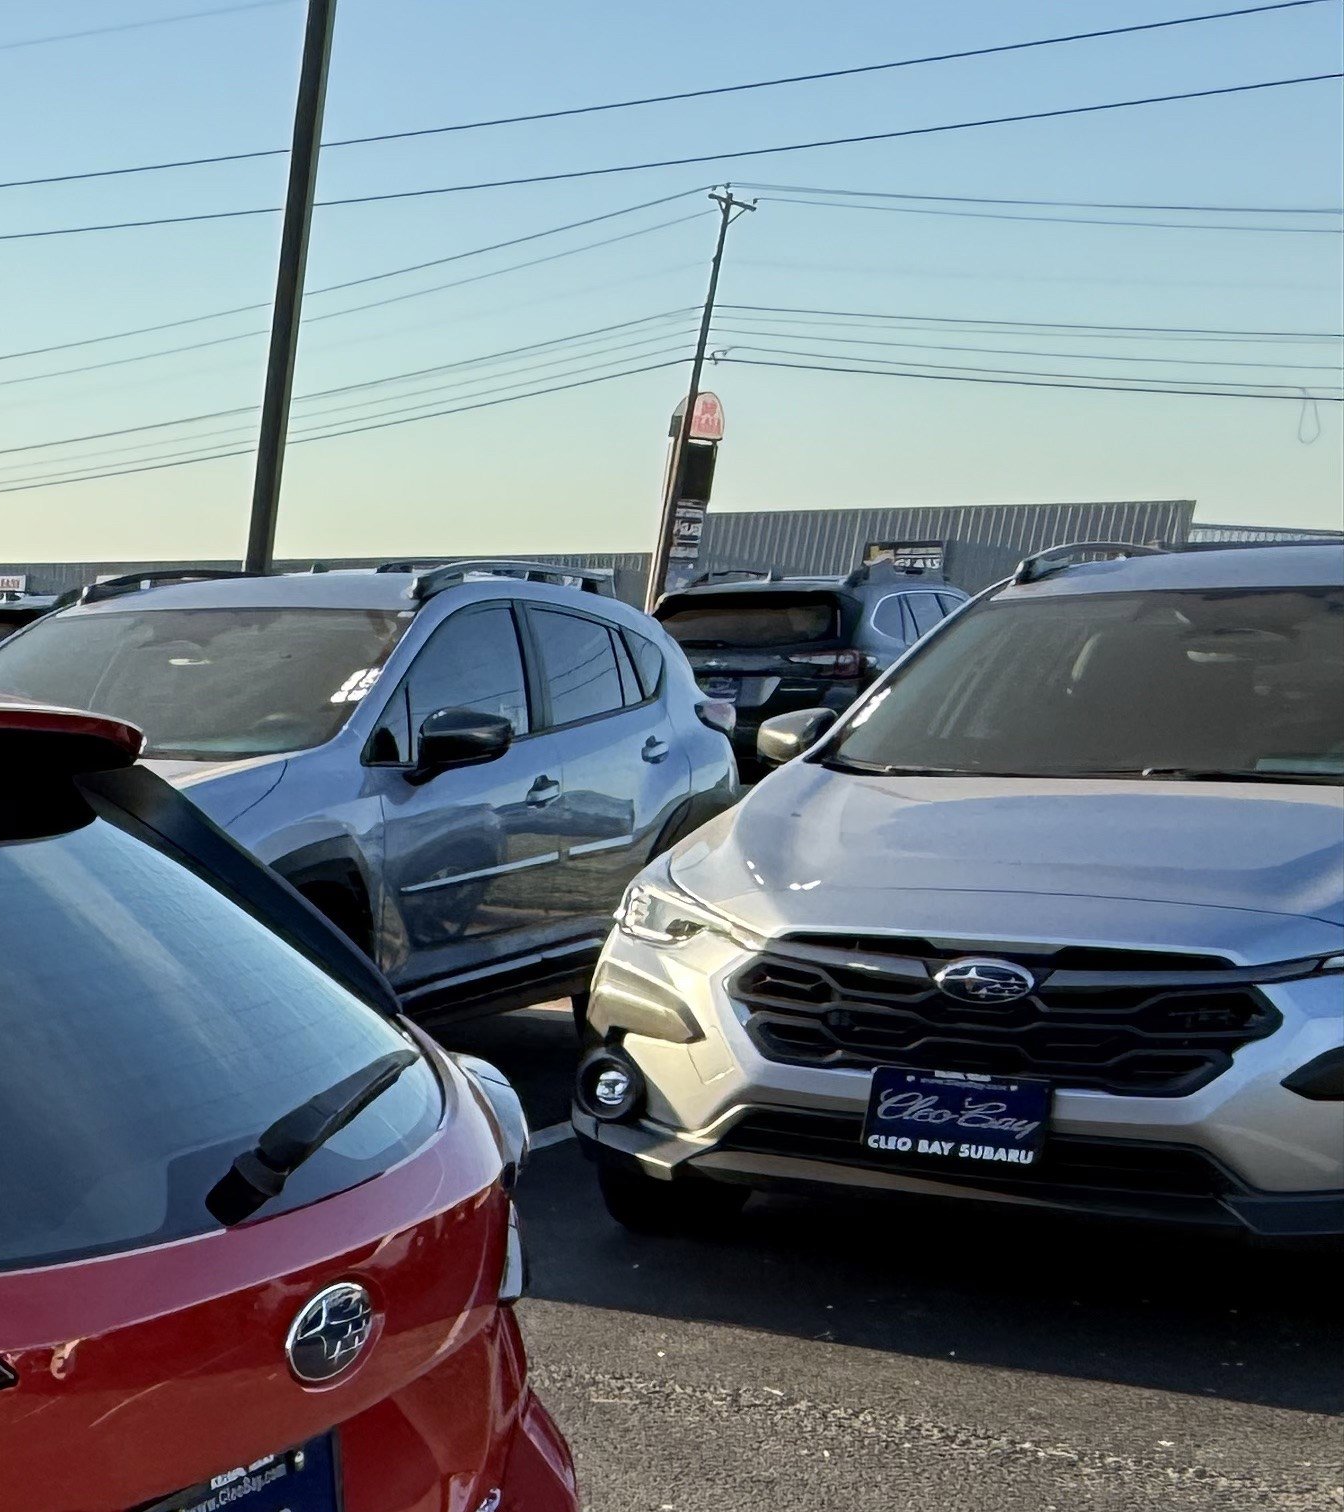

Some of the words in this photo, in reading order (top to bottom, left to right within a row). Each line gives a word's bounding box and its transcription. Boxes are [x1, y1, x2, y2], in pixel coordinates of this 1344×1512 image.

[877, 1088, 958, 1125] Cleo
[957, 1097, 1042, 1140] Bay
[867, 1134, 913, 1151] CLEO
[918, 1139, 956, 1156] BAY
[959, 1143, 1034, 1165] SUBARU
